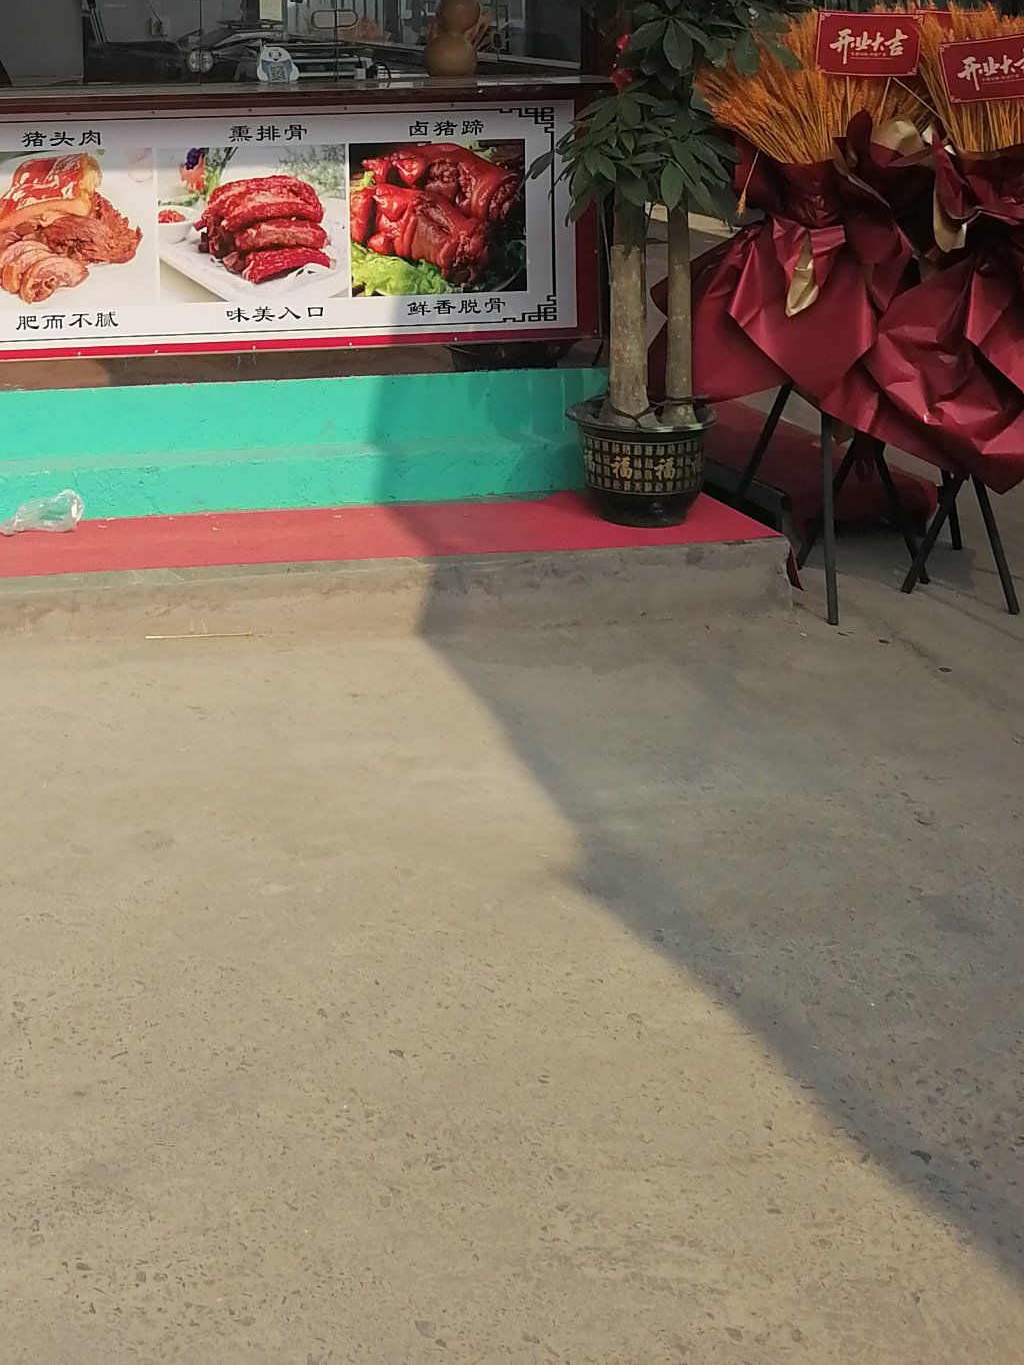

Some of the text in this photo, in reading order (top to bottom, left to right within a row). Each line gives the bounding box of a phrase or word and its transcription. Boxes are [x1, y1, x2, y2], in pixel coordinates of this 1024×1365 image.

[830, 28, 908, 65] 开业大吉
[229, 123, 308, 142] 熏排骨
[408, 119, 484, 137] 卤猪蹄
[22, 129, 102, 148] 猪头肉
[226, 305, 325, 324] 味美入口
[406, 296, 506, 316] 鲜香脱骨
[15, 310, 119, 331] 肥而不腻
